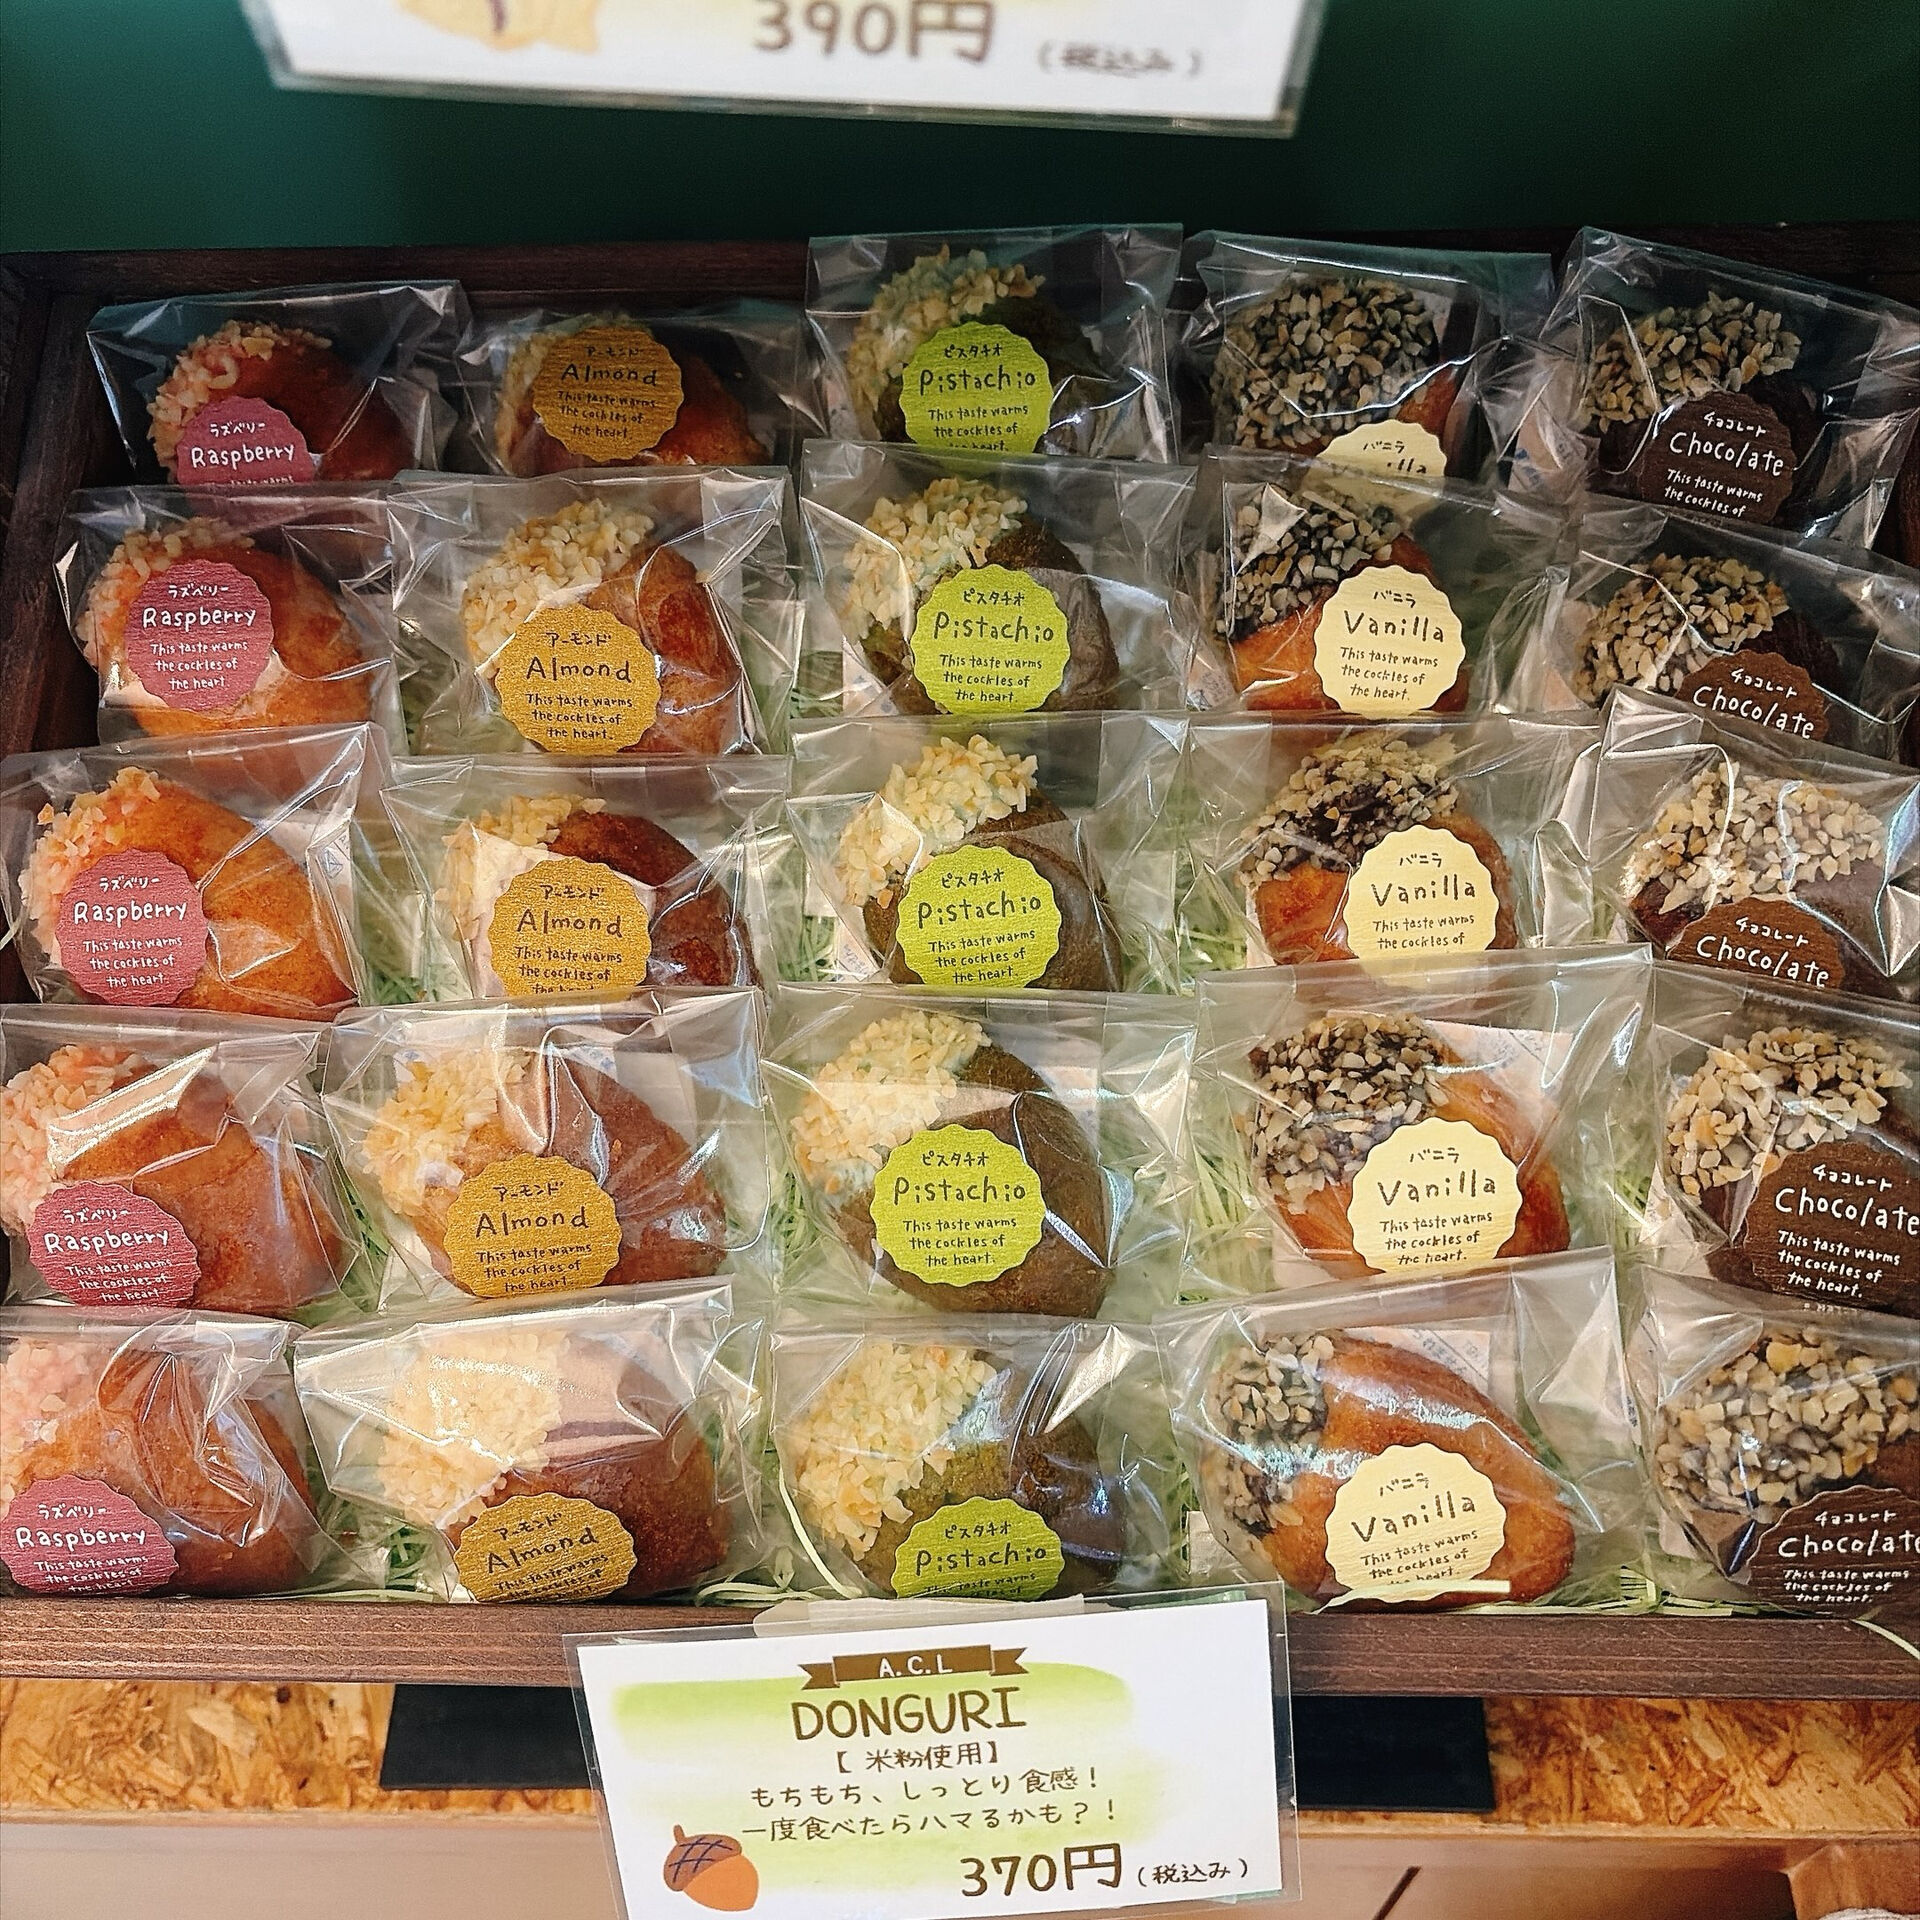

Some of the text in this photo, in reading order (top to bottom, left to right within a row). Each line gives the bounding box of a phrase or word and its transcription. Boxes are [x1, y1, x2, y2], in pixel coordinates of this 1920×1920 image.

[754, 0, 994, 63] 390円
[944, 344, 1003, 358] ピスタチオ
[561, 364, 658, 386] Almond
[920, 365, 1036, 396] Pistachio
[928, 405, 1028, 421] This taste warms
[210, 421, 266, 438] ラズベリー
[934, 422, 1018, 437] the cockles of
[1704, 411, 1766, 438] チョコレート
[191, 444, 294, 470] Raspberry
[1363, 441, 1405, 454] バニラ
[1669, 432, 1784, 476] Chocolate
[1667, 468, 1763, 503] This taste warms
[1665, 485, 1747, 518] the cockles of
[168, 582, 229, 598] ラズベリー
[963, 587, 1024, 606] ピスタチオ
[1373, 590, 1416, 609] バニラ
[143, 607, 256, 632] Raspberry
[934, 611, 1054, 643] Pistachio
[1344, 610, 1444, 643] Vanilla
[150, 642, 248, 656] This taste warms
[546, 632, 611, 647] アーモンド
[156, 658, 238, 672] the cockles of
[940, 655, 1042, 669] This taste warms
[1340, 647, 1438, 667] This taste warms
[526, 657, 632, 683] Almond
[944, 671, 1030, 687] the cockles of
[1341, 664, 1425, 685] the cockles of
[169, 678, 188, 690] the
[1350, 684, 1369, 696] the
[1731, 668, 1798, 698] チョコレート
[526, 693, 632, 707] This taste warms
[956, 689, 974, 701] the
[532, 710, 621, 725] the cockles of
[1693, 686, 1814, 739] Chocolate
[548, 728, 567, 738] the
[1399, 853, 1442, 868] バニラ
[100, 875, 160, 892] ラズベリー
[942, 868, 1004, 889] ピスタチオ
[540, 884, 604, 900] アーモンド
[1371, 874, 1475, 907] Vanilla
[74, 900, 187, 928] Raspberry
[918, 891, 1041, 929] Pistachio
[517, 909, 622, 938] Almond
[1373, 914, 1474, 933] This taste warms
[1736, 917, 1809, 947] チョコレート
[83, 937, 182, 953] This taste warms
[928, 930, 1035, 953] This taste warms
[1377, 932, 1464, 949] the cockles of
[936, 947, 1026, 968] the cockles of
[1696, 935, 1829, 988] Chocolate
[953, 972, 975, 984] the
[922, 1150, 989, 1167] ピスタチオ
[1410, 1147, 1459, 1163] バニラ
[1377, 1169, 1496, 1206] Vanilla
[1813, 1164, 1893, 1192] チョコレート
[493, 1181, 564, 1201] アーモンド
[894, 1176, 1026, 1206] Pistachio
[63, 1207, 128, 1225] ラズベリー
[476, 1206, 589, 1238] Almond
[1775, 1188, 1920, 1235] Chocolate
[903, 1218, 1017, 1233] This taste warms
[1380, 1212, 1492, 1233] This taste warms
[44, 1229, 168, 1255] Raspberry
[910, 1235, 1005, 1249] the cockles of
[1385, 1231, 1480, 1250] the cockles of
[1778, 1230, 1900, 1265] This taste warms
[926, 1255, 947, 1267] the
[1398, 1255, 1419, 1265] the
[1778, 1250, 1882, 1283] the cockles of
[1788, 1271, 1811, 1287] the
[1379, 1472, 1430, 1497] バニラ
[38, 1503, 107, 1520] ラズベリー
[1351, 1491, 1476, 1542] Vanilla
[1815, 1510, 1897, 1527] チョコレート
[493, 1512, 562, 1541] アーモンド
[945, 1521, 1011, 1539] ピスタチオ
[15, 1527, 146, 1551] Raspberry
[1360, 1531, 1478, 1566] This taste warms
[487, 1527, 599, 1573] Almond
[915, 1543, 1047, 1576] Pistachio
[1369, 1549, 1470, 1579] the cockles of
[878, 1654, 954, 1679] A.C.L
[791, 1686, 1029, 1741] DONGURI
[959, 1841, 1250, 1897] 370円 （税込み）
